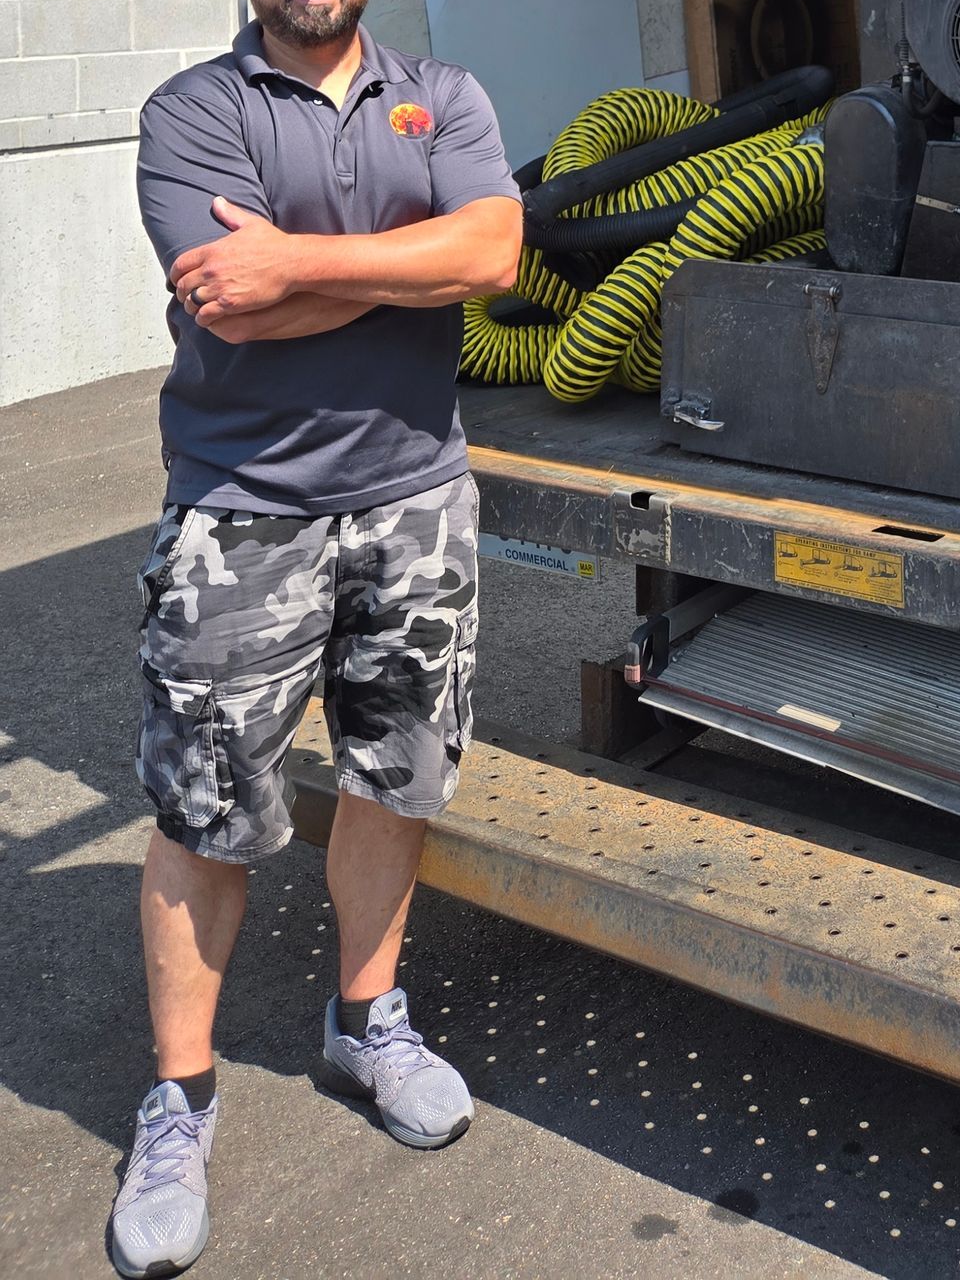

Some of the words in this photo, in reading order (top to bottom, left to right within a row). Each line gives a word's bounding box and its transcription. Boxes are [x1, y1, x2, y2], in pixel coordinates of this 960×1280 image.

[795, 537, 819, 547] OPERATING
[819, 542, 852, 554] INSTRUCTIONS
[852, 548, 862, 556] FOR
[504, 548, 569, 571] COMMERCIAL
[579, 562, 593, 572] MAR
[390, 997, 403, 1014] NIKE
[146, 1095, 159, 1113] NIKE
